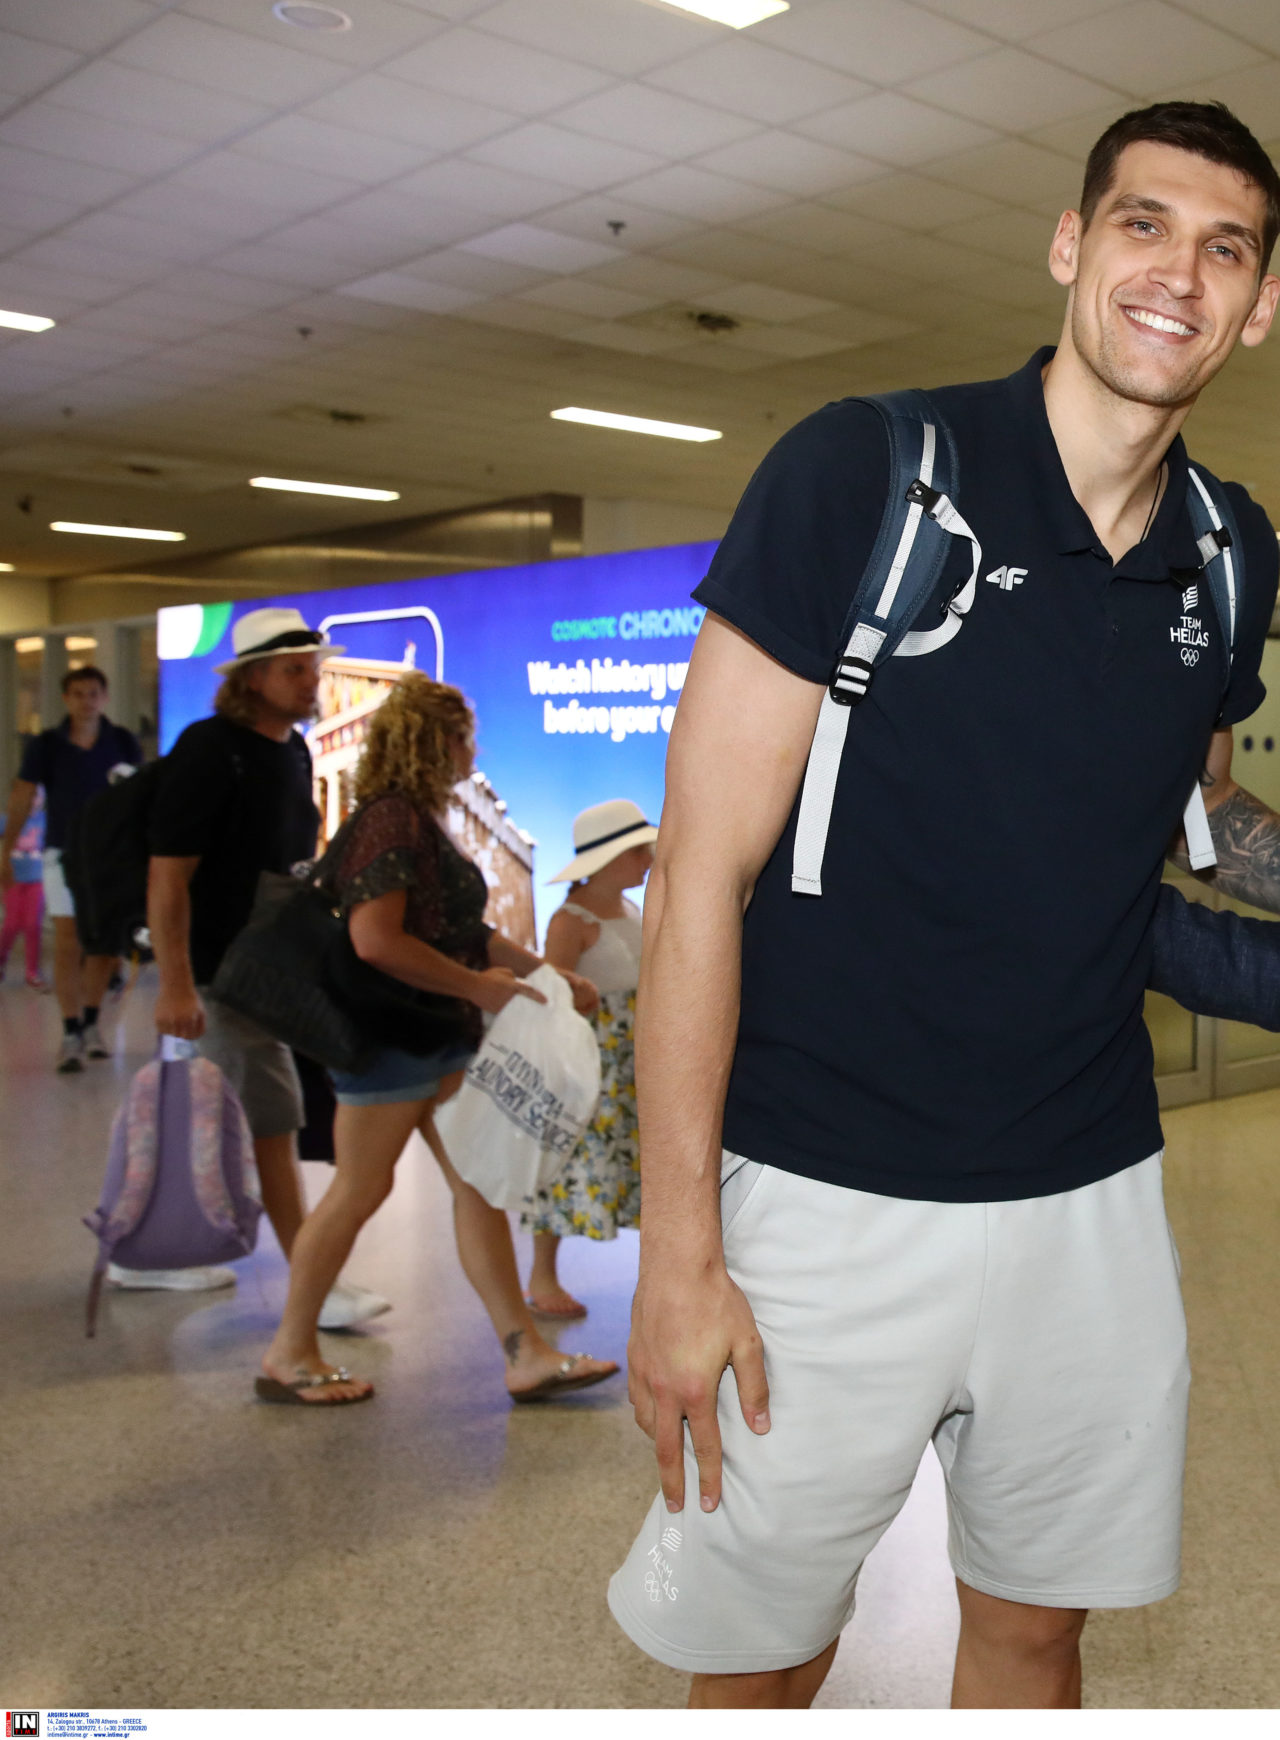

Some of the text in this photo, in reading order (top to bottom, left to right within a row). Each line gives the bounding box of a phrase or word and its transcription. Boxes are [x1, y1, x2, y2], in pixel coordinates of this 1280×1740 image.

[985, 565, 1029, 591] 4F
[1179, 616, 1202, 630] TEAM
[1169, 627, 1209, 648] HELLAS
[527, 659, 591, 695] Watch
[591, 657, 666, 700] history
[544, 699, 609, 734] before
[610, 705, 661, 742] your
